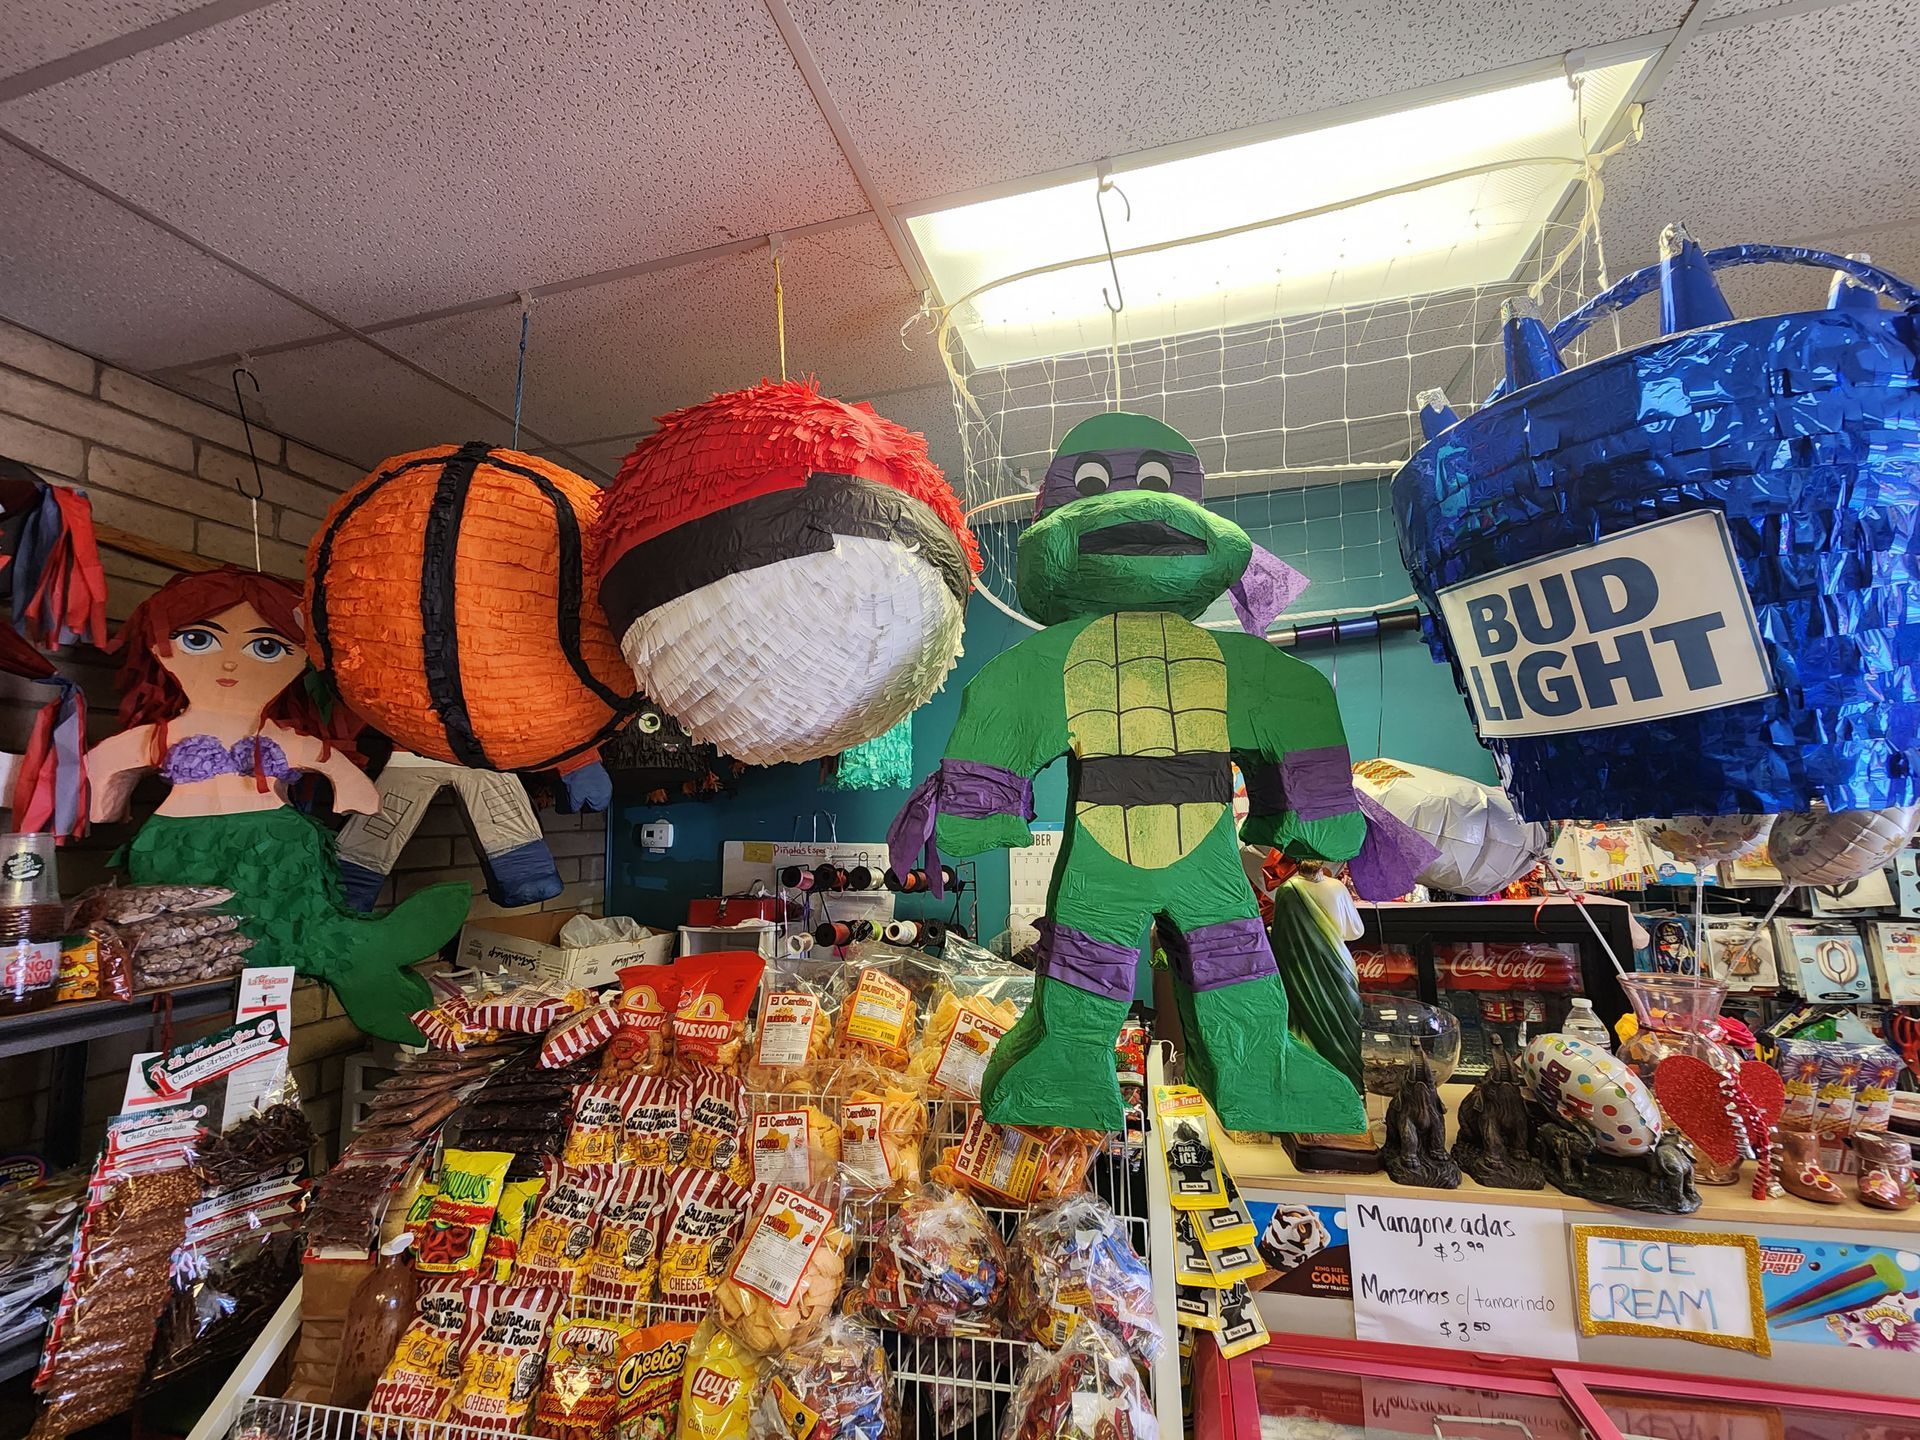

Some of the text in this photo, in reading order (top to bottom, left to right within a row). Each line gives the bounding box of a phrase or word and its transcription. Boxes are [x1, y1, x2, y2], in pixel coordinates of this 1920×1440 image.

[1466, 557, 1659, 658] BUD
[1470, 612, 1726, 721] LIGHT
[1031, 834, 1051, 846] OBER
[773, 844, 806, 856] Piñatas
[1451, 950, 1546, 978] Coca-Cola
[865, 972, 876, 982] El
[770, 996, 813, 1007] El Cerdito
[961, 1013, 973, 1025] El
[172, 1069, 194, 1084] Chile
[195, 1064, 205, 1072] de
[233, 1040, 266, 1055] Tostado
[1159, 1095, 1201, 1112] Little Trees
[759, 1115, 803, 1128] El Cerdito
[845, 1107, 876, 1119] Cerdito
[125, 1124, 187, 1142] Chile Quebrado
[958, 1115, 983, 1170] El Cerdito
[1178, 1145, 1196, 1153] BLACK
[1179, 1151, 1198, 1165] ICE
[215, 1198, 224, 1207] de
[255, 1180, 290, 1194] Tostado
[775, 1192, 825, 1224] El Cerdito
[1357, 1204, 1516, 1247] Mangoneadas
[1598, 1240, 1696, 1275] ICE
[592, 1262, 620, 1280] CHEESE
[1760, 1263, 1799, 1274] POP
[669, 1278, 703, 1291] CHEESE
[1311, 1273, 1349, 1285] CONE
[1361, 1273, 1449, 1305] Manzanas
[1476, 1288, 1555, 1312] tamarindo
[1589, 1283, 1718, 1329] CREAM
[443, 1312, 463, 1329] FOOD
[491, 1310, 541, 1332] CALIFORNIA
[508, 1328, 540, 1346] FOODS
[619, 1343, 687, 1393] Cheetos
[393, 1369, 432, 1389] CHEESE
[372, 1382, 450, 1420] OPCORN
[464, 1394, 505, 1414] CHEESE
[687, 1418, 717, 1437] Classic
